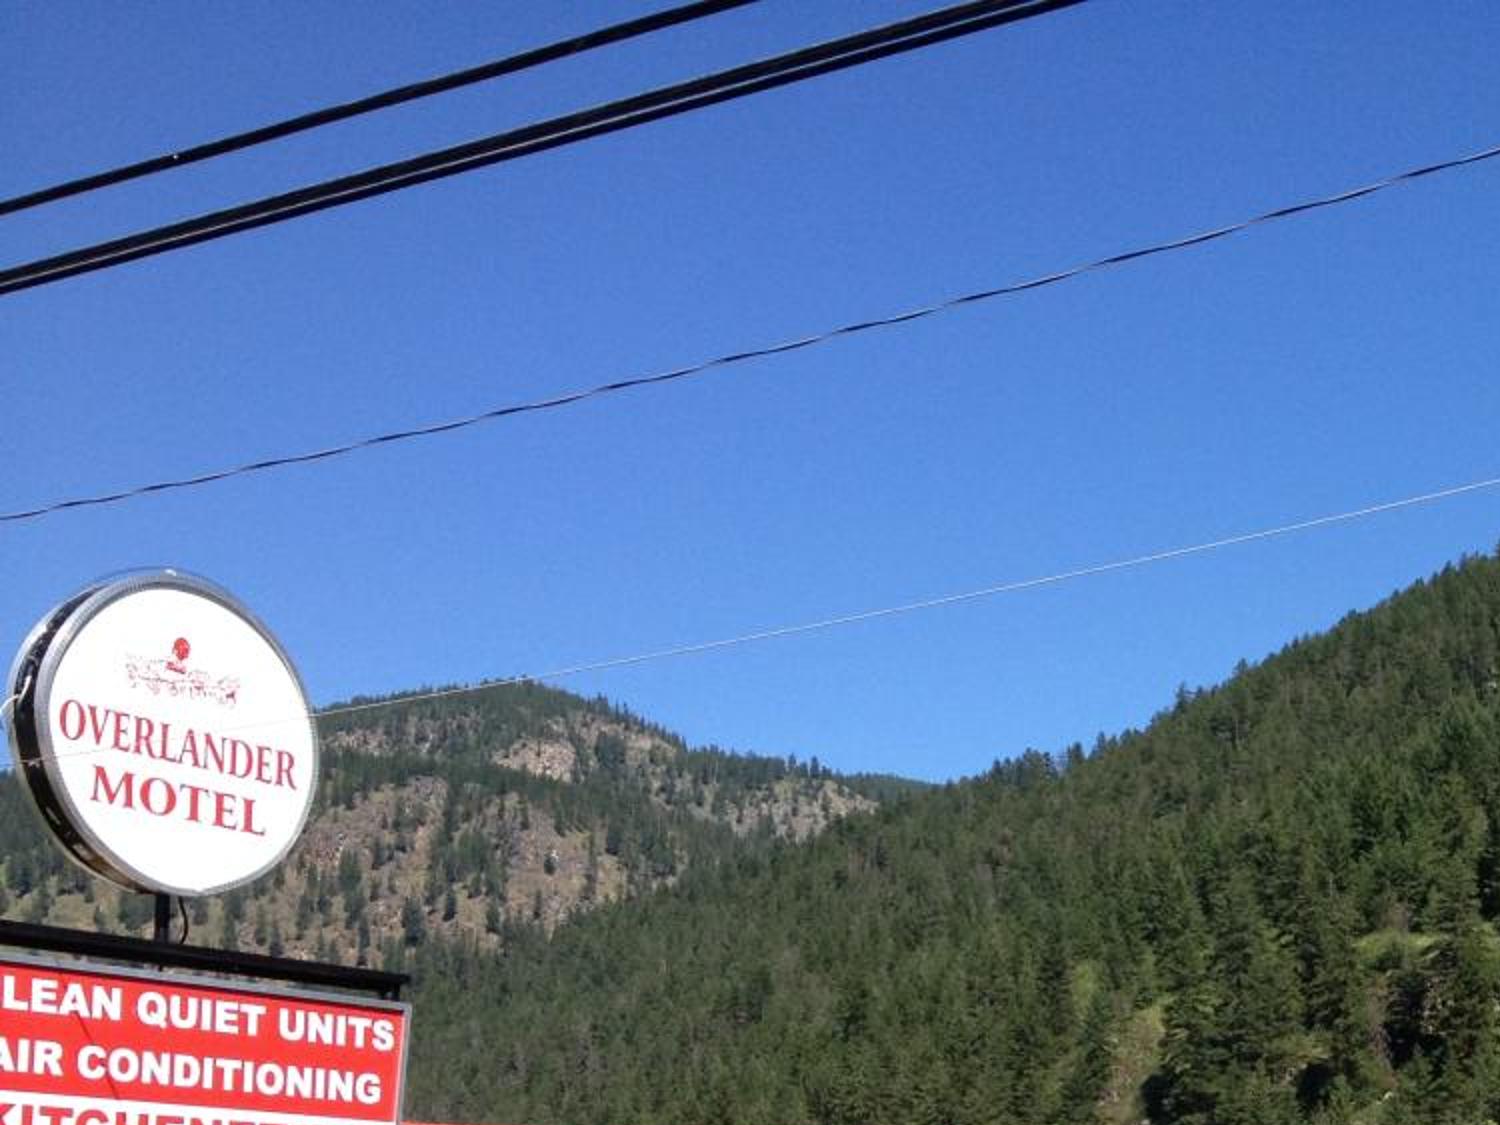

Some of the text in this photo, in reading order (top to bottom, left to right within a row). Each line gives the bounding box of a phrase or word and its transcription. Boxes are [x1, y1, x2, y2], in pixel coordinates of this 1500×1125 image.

[59, 699, 298, 790] OVERLANDER
[90, 764, 267, 837] MOTEL
[137, 991, 267, 1037] QUIET
[279, 1008, 395, 1052] UNITS
[77, 1045, 382, 1104] CONDITIONING
